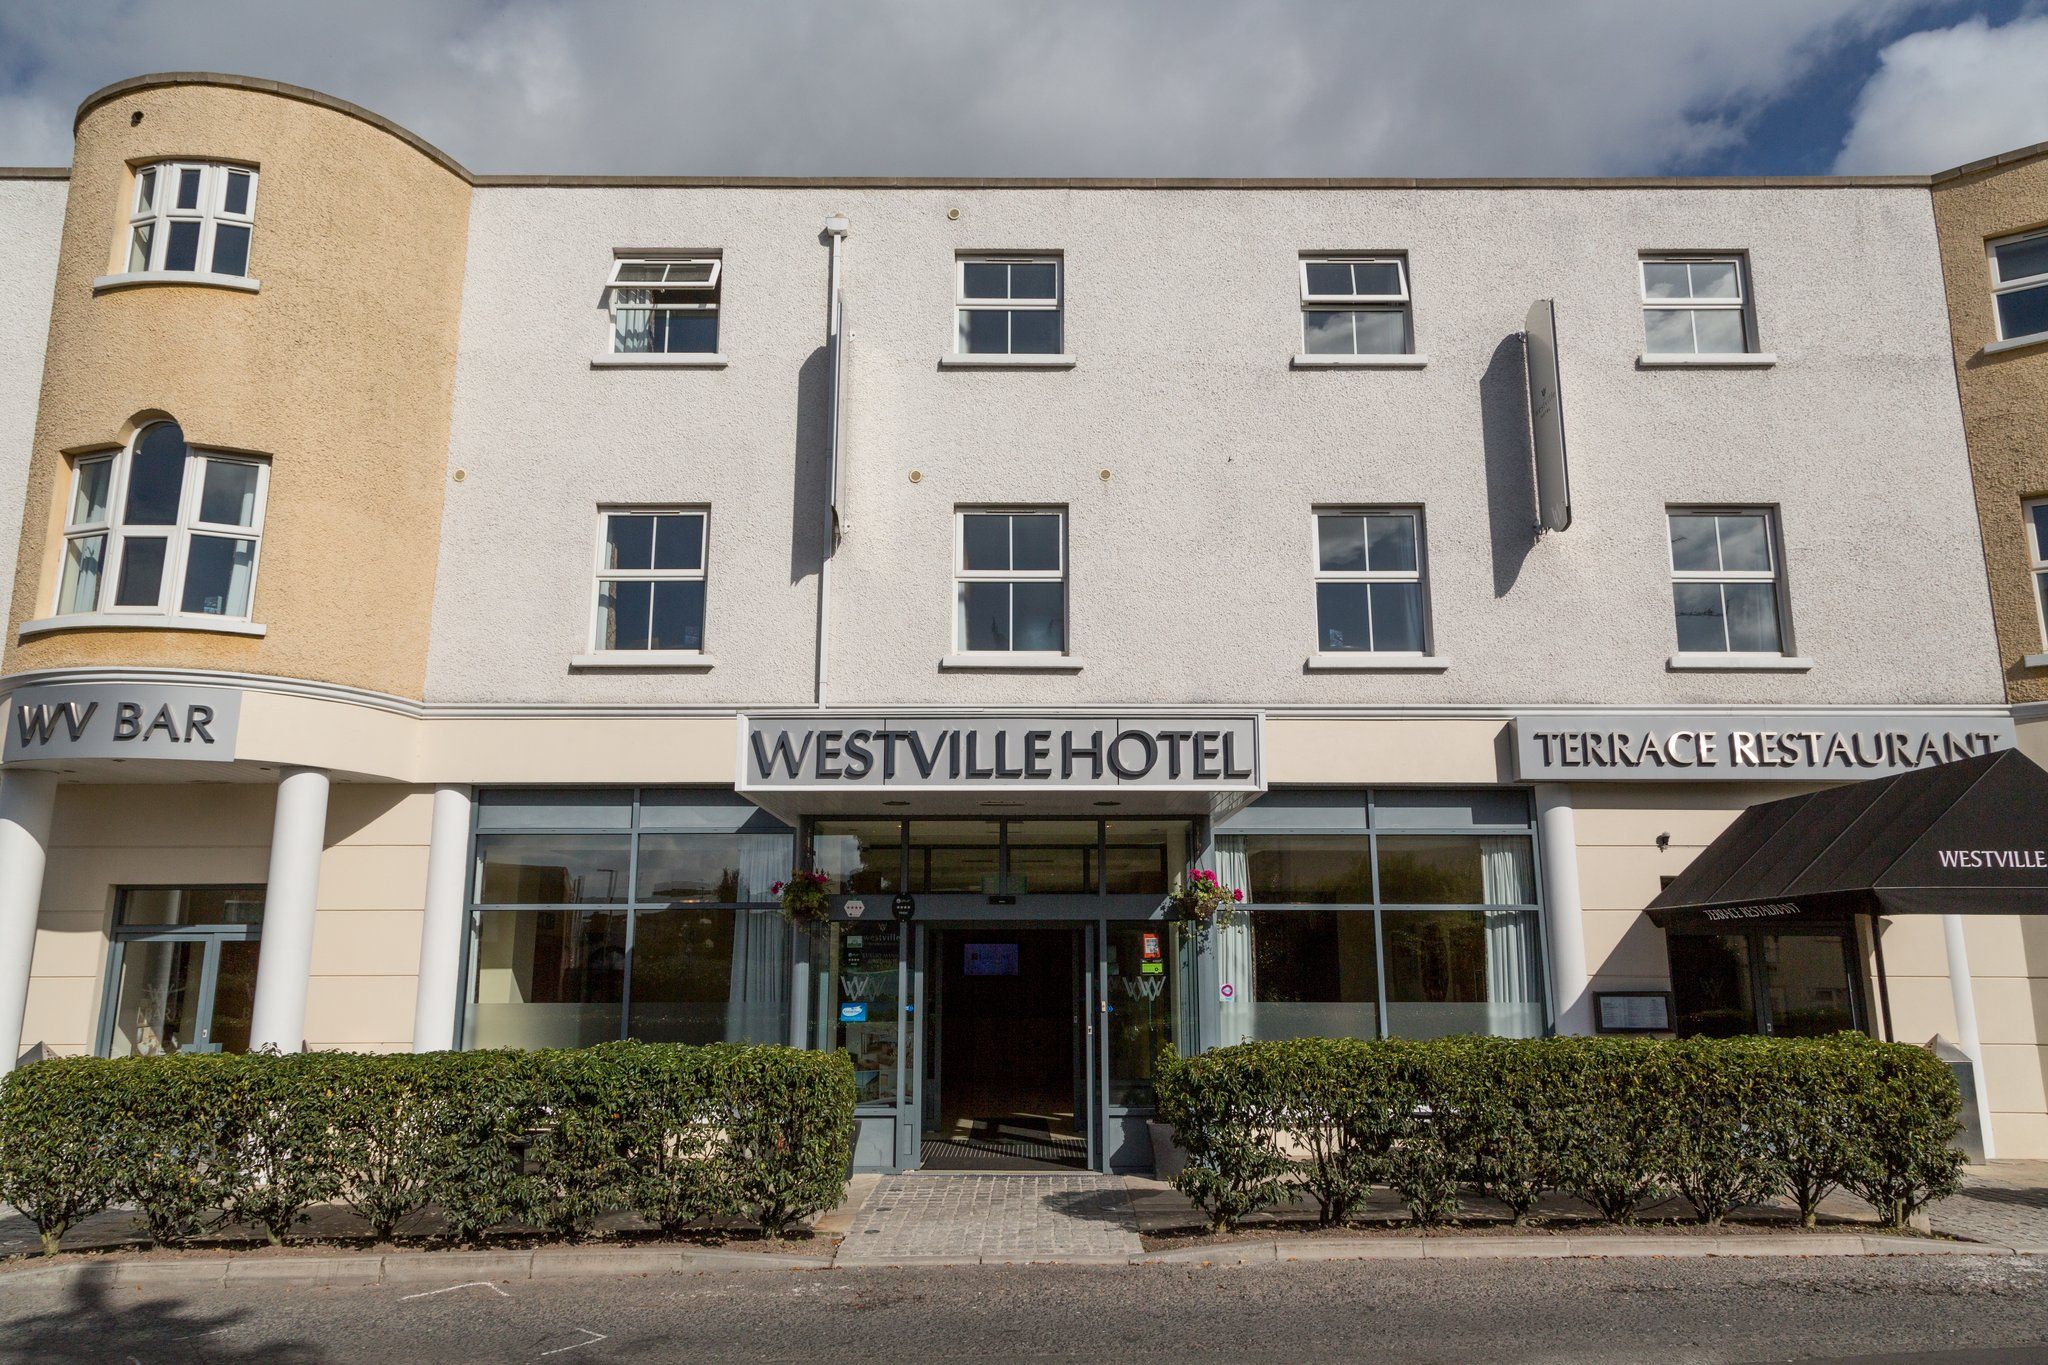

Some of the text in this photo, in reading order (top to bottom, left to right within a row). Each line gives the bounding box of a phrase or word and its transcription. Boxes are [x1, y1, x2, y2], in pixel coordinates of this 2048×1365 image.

[18, 701, 215, 747] WV BAR
[751, 729, 1252, 780] WESTVILLE HOTEL
[1533, 730, 2002, 768] TERRACE RESTAURANT
[1938, 850, 2048, 868] WESTVILLE
[1703, 902, 1800, 920] TERRACE RESTAURANT
